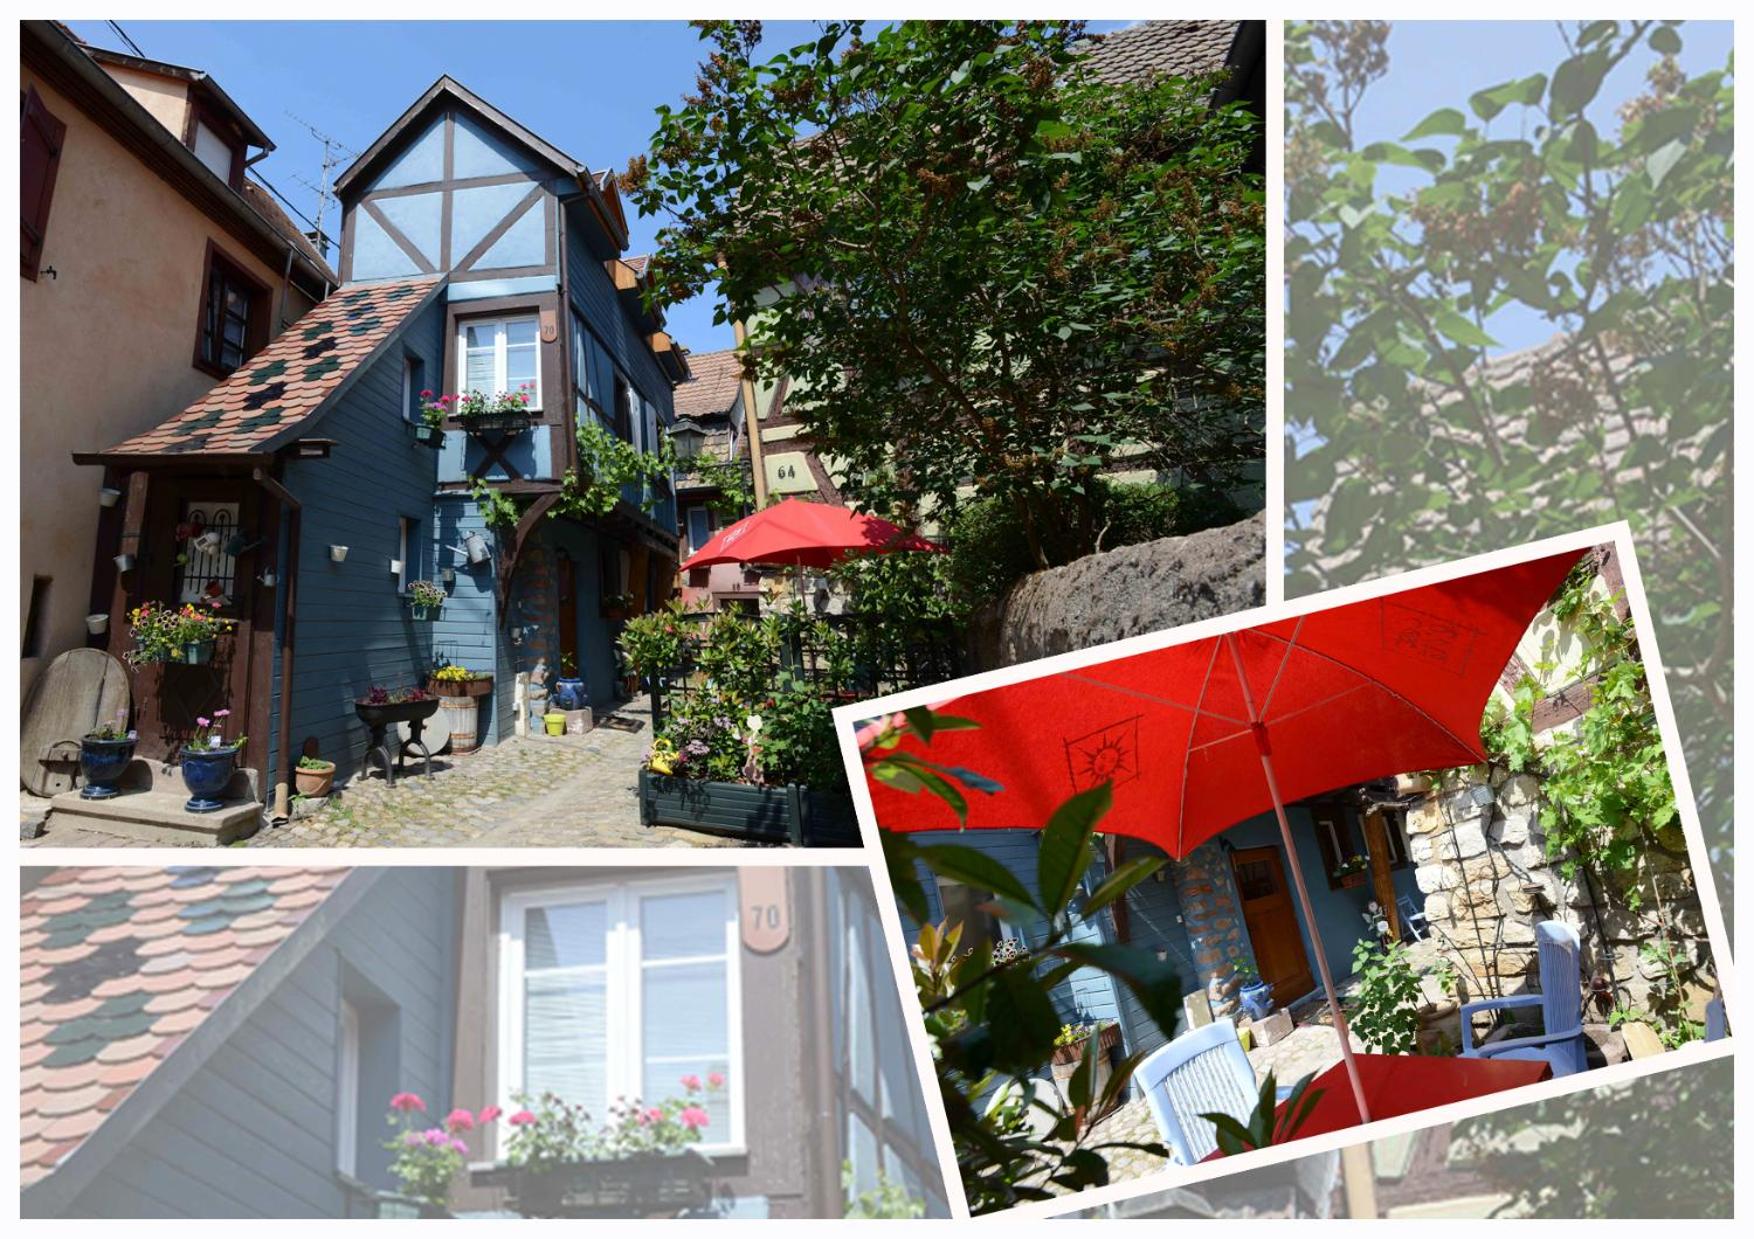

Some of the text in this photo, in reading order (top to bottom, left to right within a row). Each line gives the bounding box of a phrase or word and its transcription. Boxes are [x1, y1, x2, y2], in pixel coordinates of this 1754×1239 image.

[544, 325, 555, 335] 70
[778, 465, 795, 479] 64
[751, 905, 780, 929] 70
